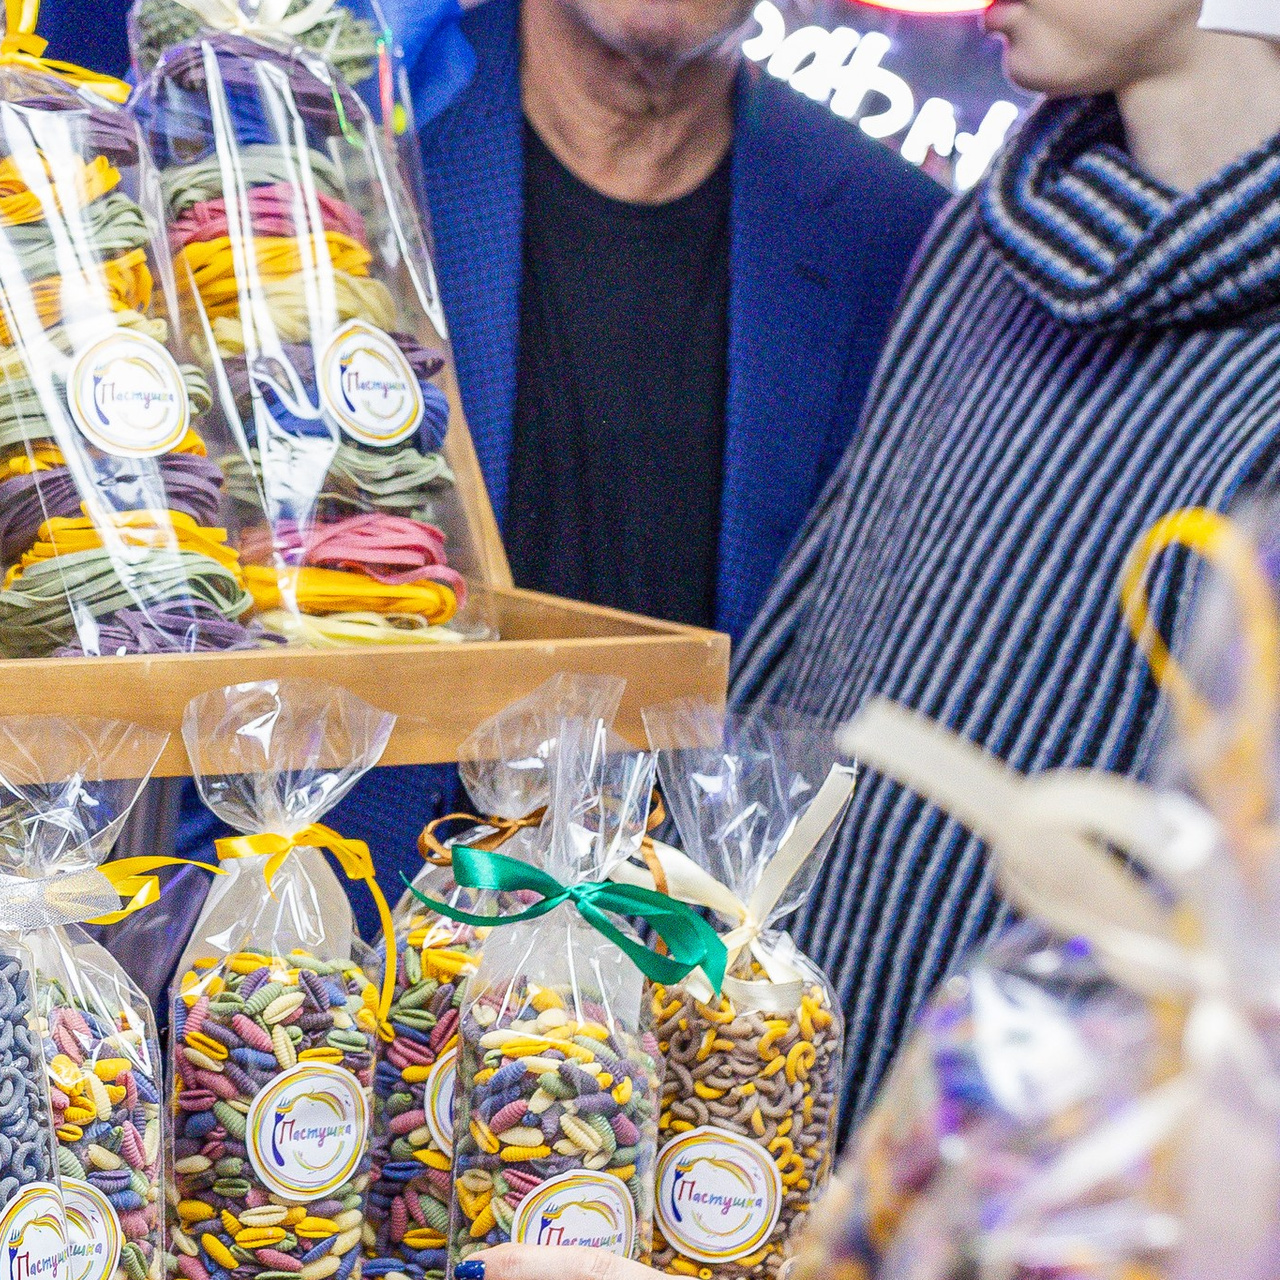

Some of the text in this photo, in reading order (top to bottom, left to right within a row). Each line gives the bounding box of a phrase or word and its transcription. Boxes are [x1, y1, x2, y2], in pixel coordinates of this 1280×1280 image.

[346, 371, 407, 398] Пастушка
[279, 1118, 352, 1149] Пастушка
[677, 1179, 763, 1216] Пастушка
